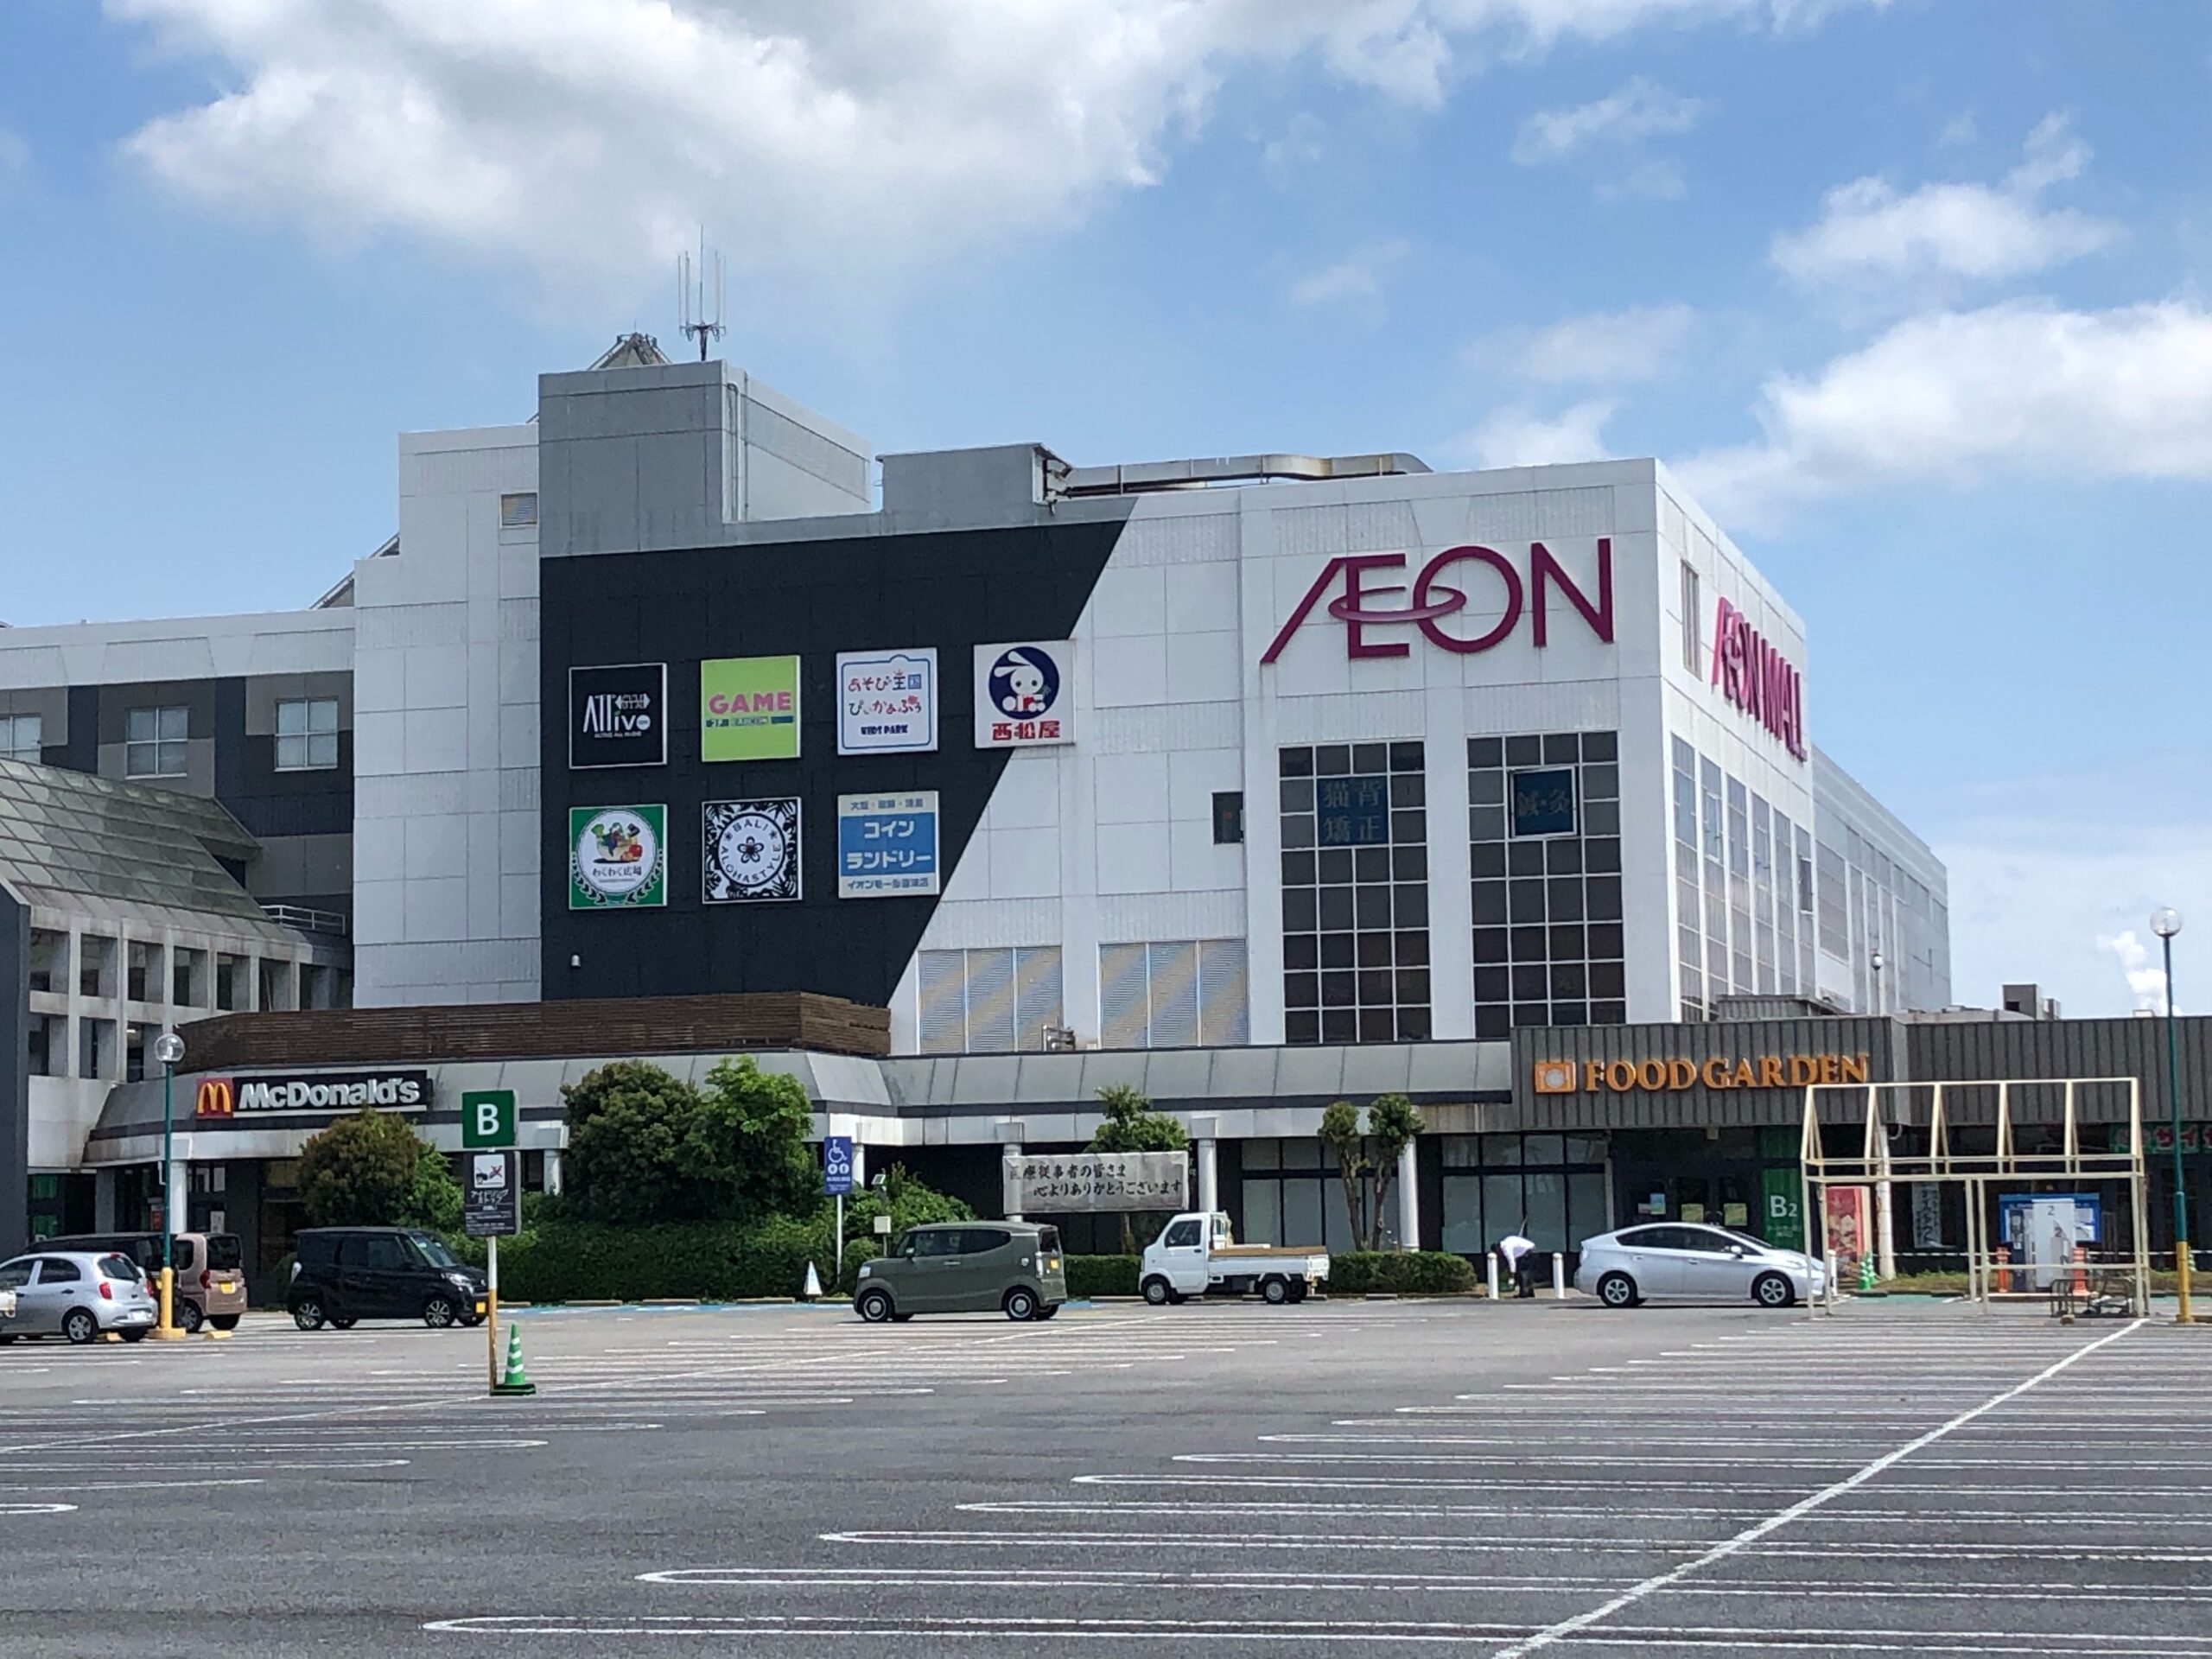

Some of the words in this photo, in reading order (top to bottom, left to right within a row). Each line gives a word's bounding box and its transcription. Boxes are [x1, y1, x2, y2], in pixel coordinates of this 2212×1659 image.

[1260, 537, 1614, 664] AEON
[709, 691, 791, 715] GAME
[992, 720, 1060, 741] 西松屋
[1324, 779, 1382, 809] 猫背
[733, 818, 769, 832] BALI
[864, 820, 914, 839] コイン
[1324, 814, 1382, 843] 矯正
[847, 849, 931, 869] ランドリー
[1584, 1058, 1697, 1093] FOOD
[1701, 1052, 1869, 1090] GARDEN
[238, 1077, 420, 1109] McDonald's
[477, 1103, 499, 1136] B
